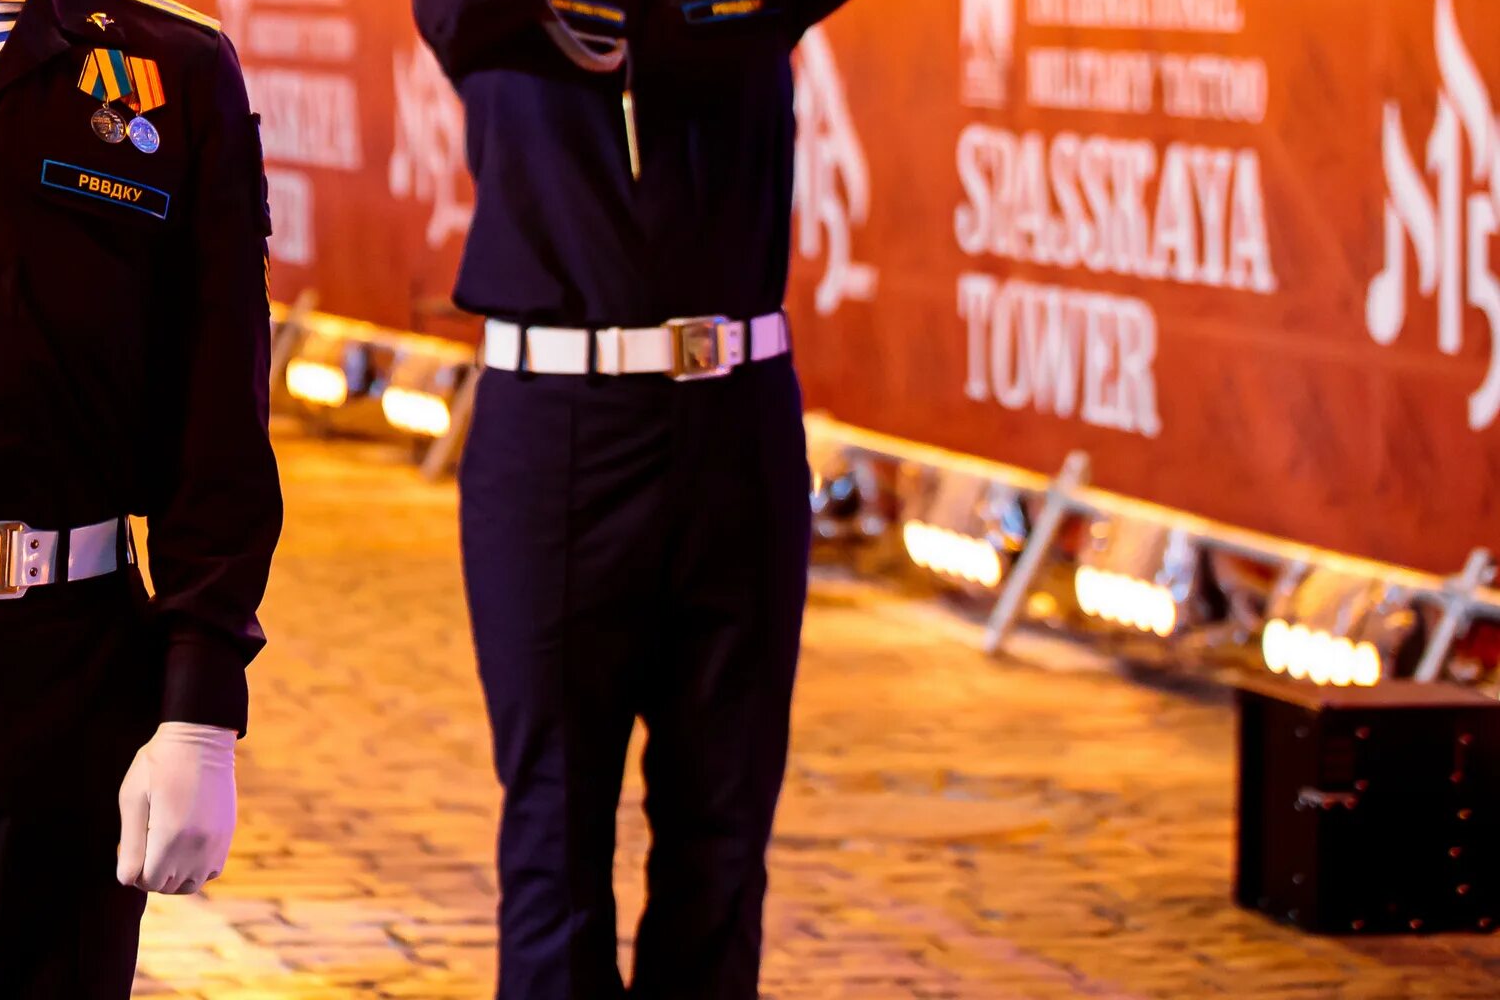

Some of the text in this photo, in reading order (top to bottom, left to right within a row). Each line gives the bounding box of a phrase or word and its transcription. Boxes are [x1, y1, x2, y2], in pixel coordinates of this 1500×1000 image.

[78, 173, 142, 202] РВВДКУ
[955, 123, 1277, 294] SPASSKAYA
[957, 272, 1162, 438] TOWER
